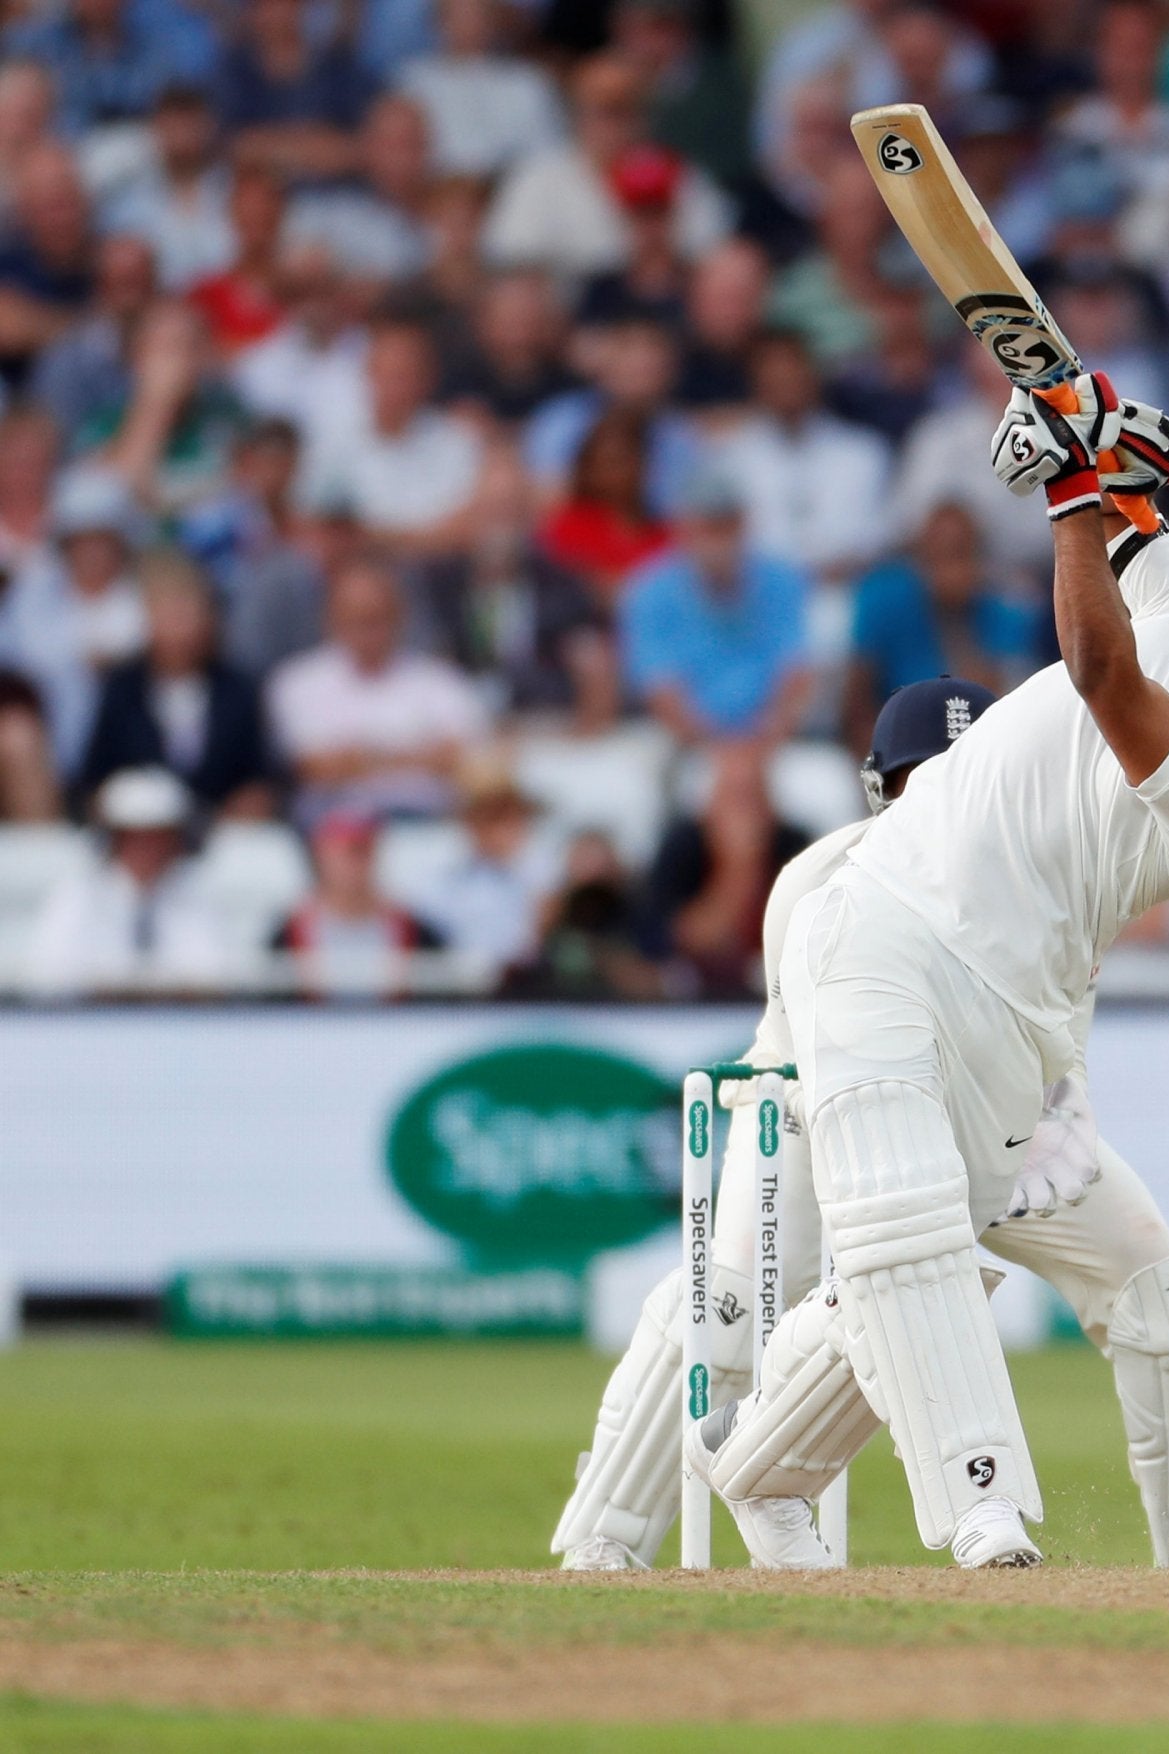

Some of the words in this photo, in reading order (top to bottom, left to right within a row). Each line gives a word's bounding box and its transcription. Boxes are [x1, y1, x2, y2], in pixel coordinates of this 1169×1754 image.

[694, 1104, 705, 1154] Specsavers
[764, 1103, 775, 1153] Specsavers
[762, 1173, 778, 1214] The
[689, 1197, 709, 1324] Specsavers
[762, 1218, 778, 1262] Test
[695, 1367, 705, 1417] Specsavers
